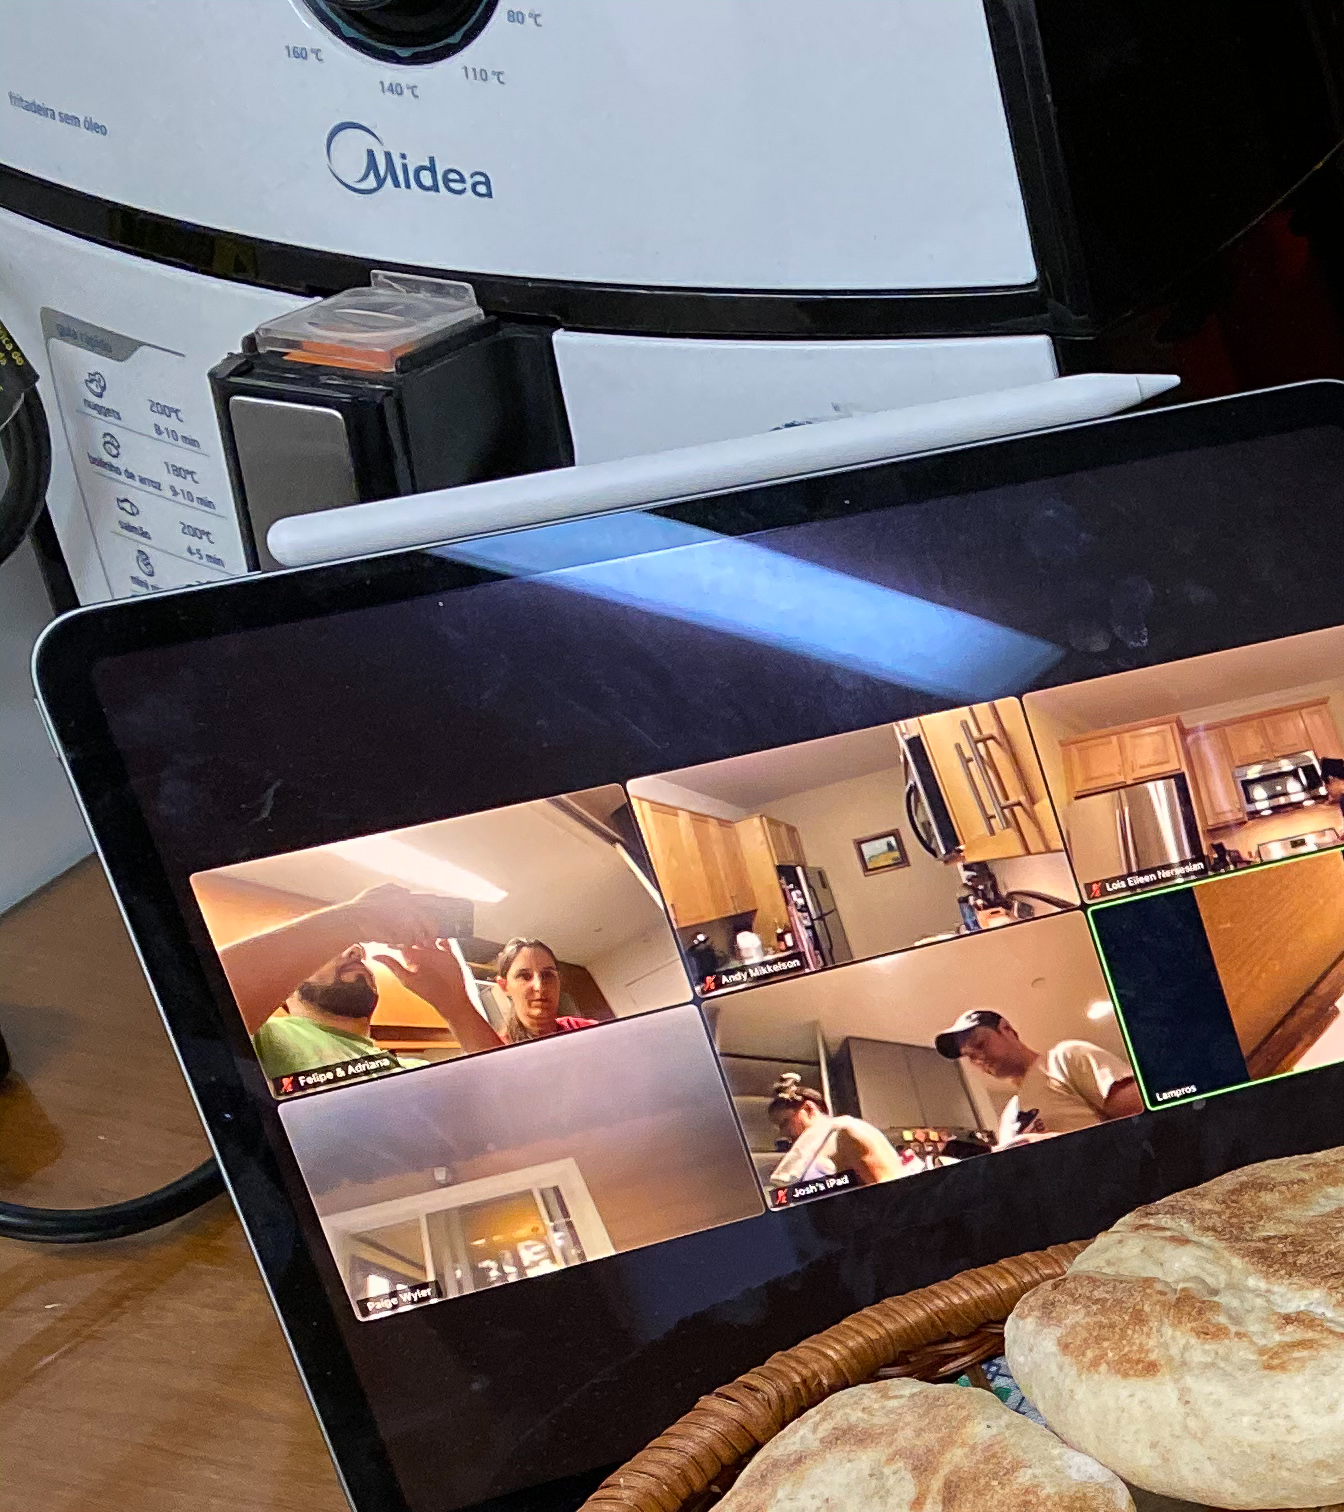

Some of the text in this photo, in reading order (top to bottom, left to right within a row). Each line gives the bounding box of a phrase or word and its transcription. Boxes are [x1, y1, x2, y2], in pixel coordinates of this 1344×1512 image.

[506, 9, 524, 25] 80
[285, 44, 308, 61] 160
[461, 66, 488, 82] 110
[379, 80, 403, 96] 140
[59, 111, 81, 128] sem
[83, 116, 107, 136] óleo
[353, 148, 493, 199] Midea
[181, 433, 201, 449] min
[196, 495, 216, 510] min
[205, 552, 225, 568] min
[1105, 879, 1127, 892] Lois
[721, 971, 747, 985] Andy
[298, 1058, 391, 1087] Felipe & Adriana
[1155, 1084, 1197, 1101] Lampros
[793, 1174, 850, 1198] Josh's iPad
[366, 1297, 398, 1312] Paige
